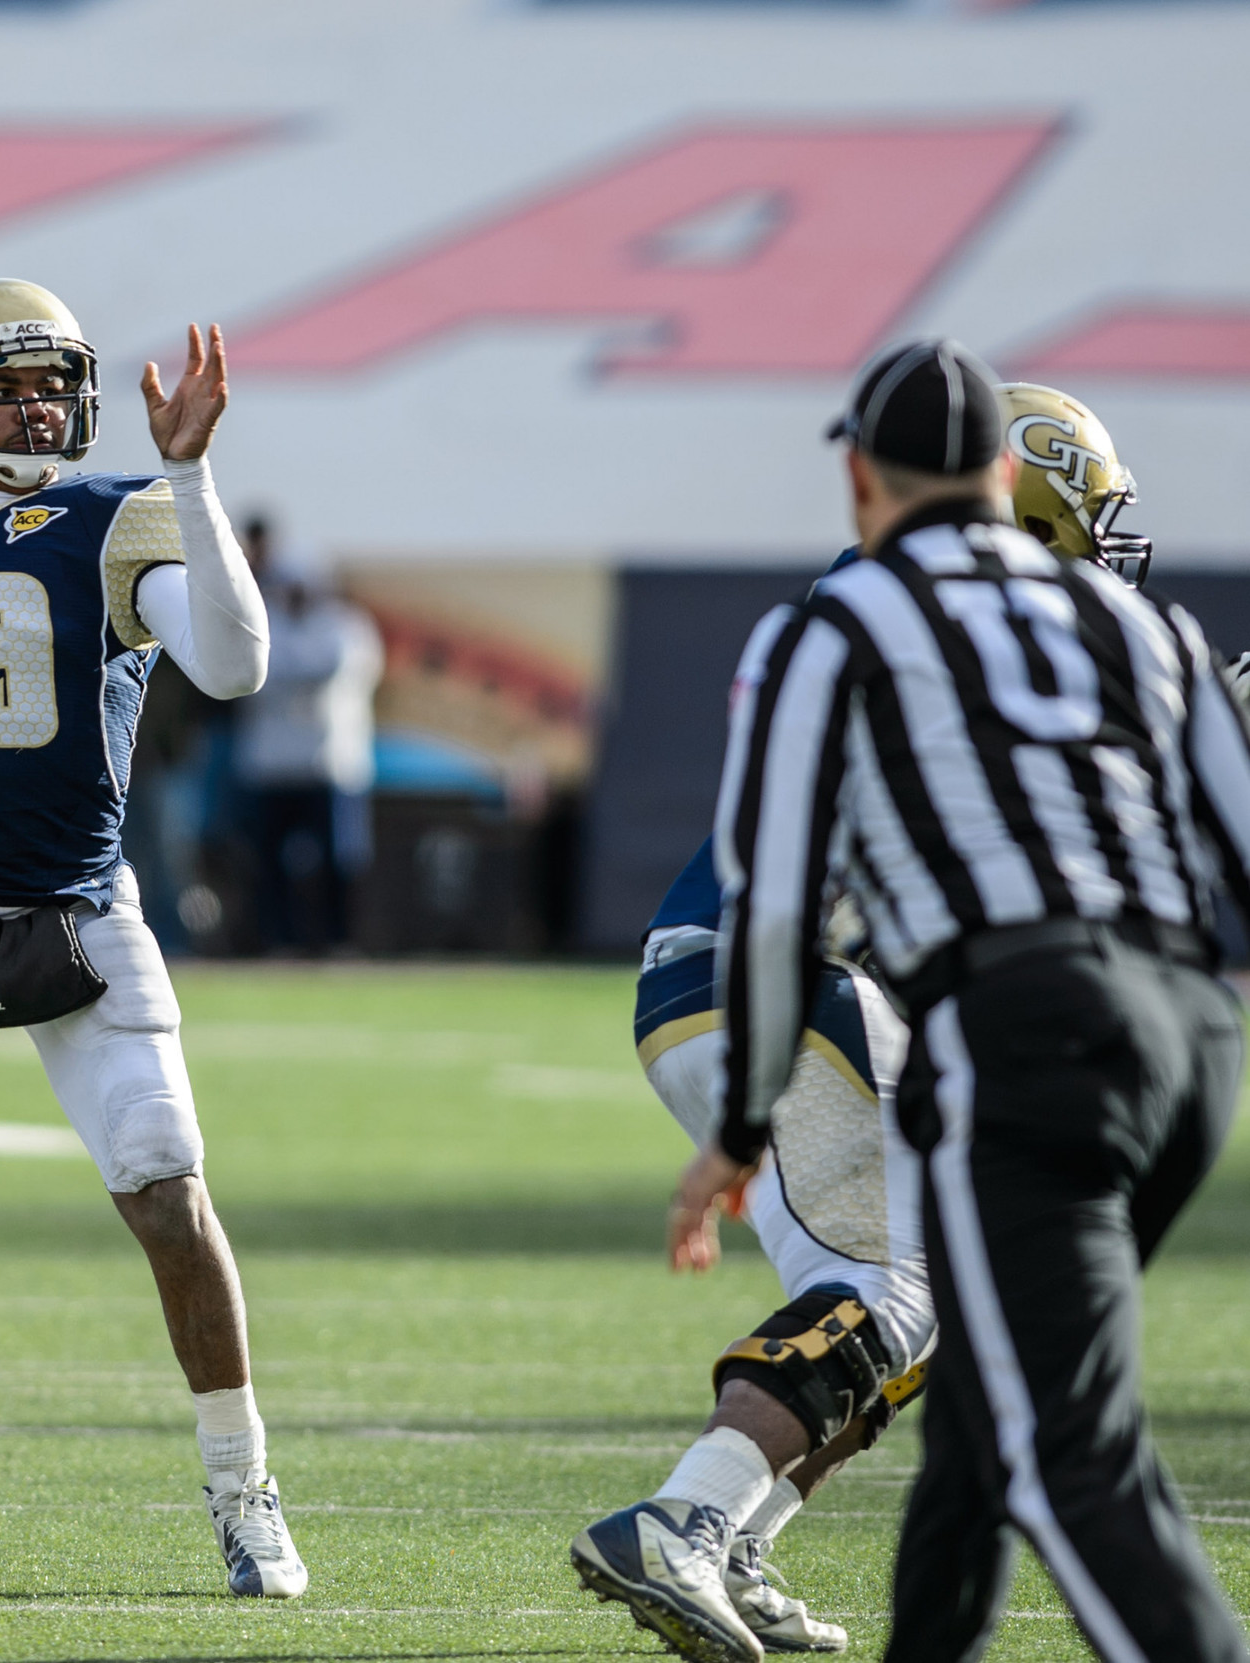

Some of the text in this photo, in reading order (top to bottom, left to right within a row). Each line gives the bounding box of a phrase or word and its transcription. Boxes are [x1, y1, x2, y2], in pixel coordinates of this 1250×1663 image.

[15, 323, 46, 335] ACC
[1007, 413, 1105, 491] GT
[14, 514, 45, 525] ACC
